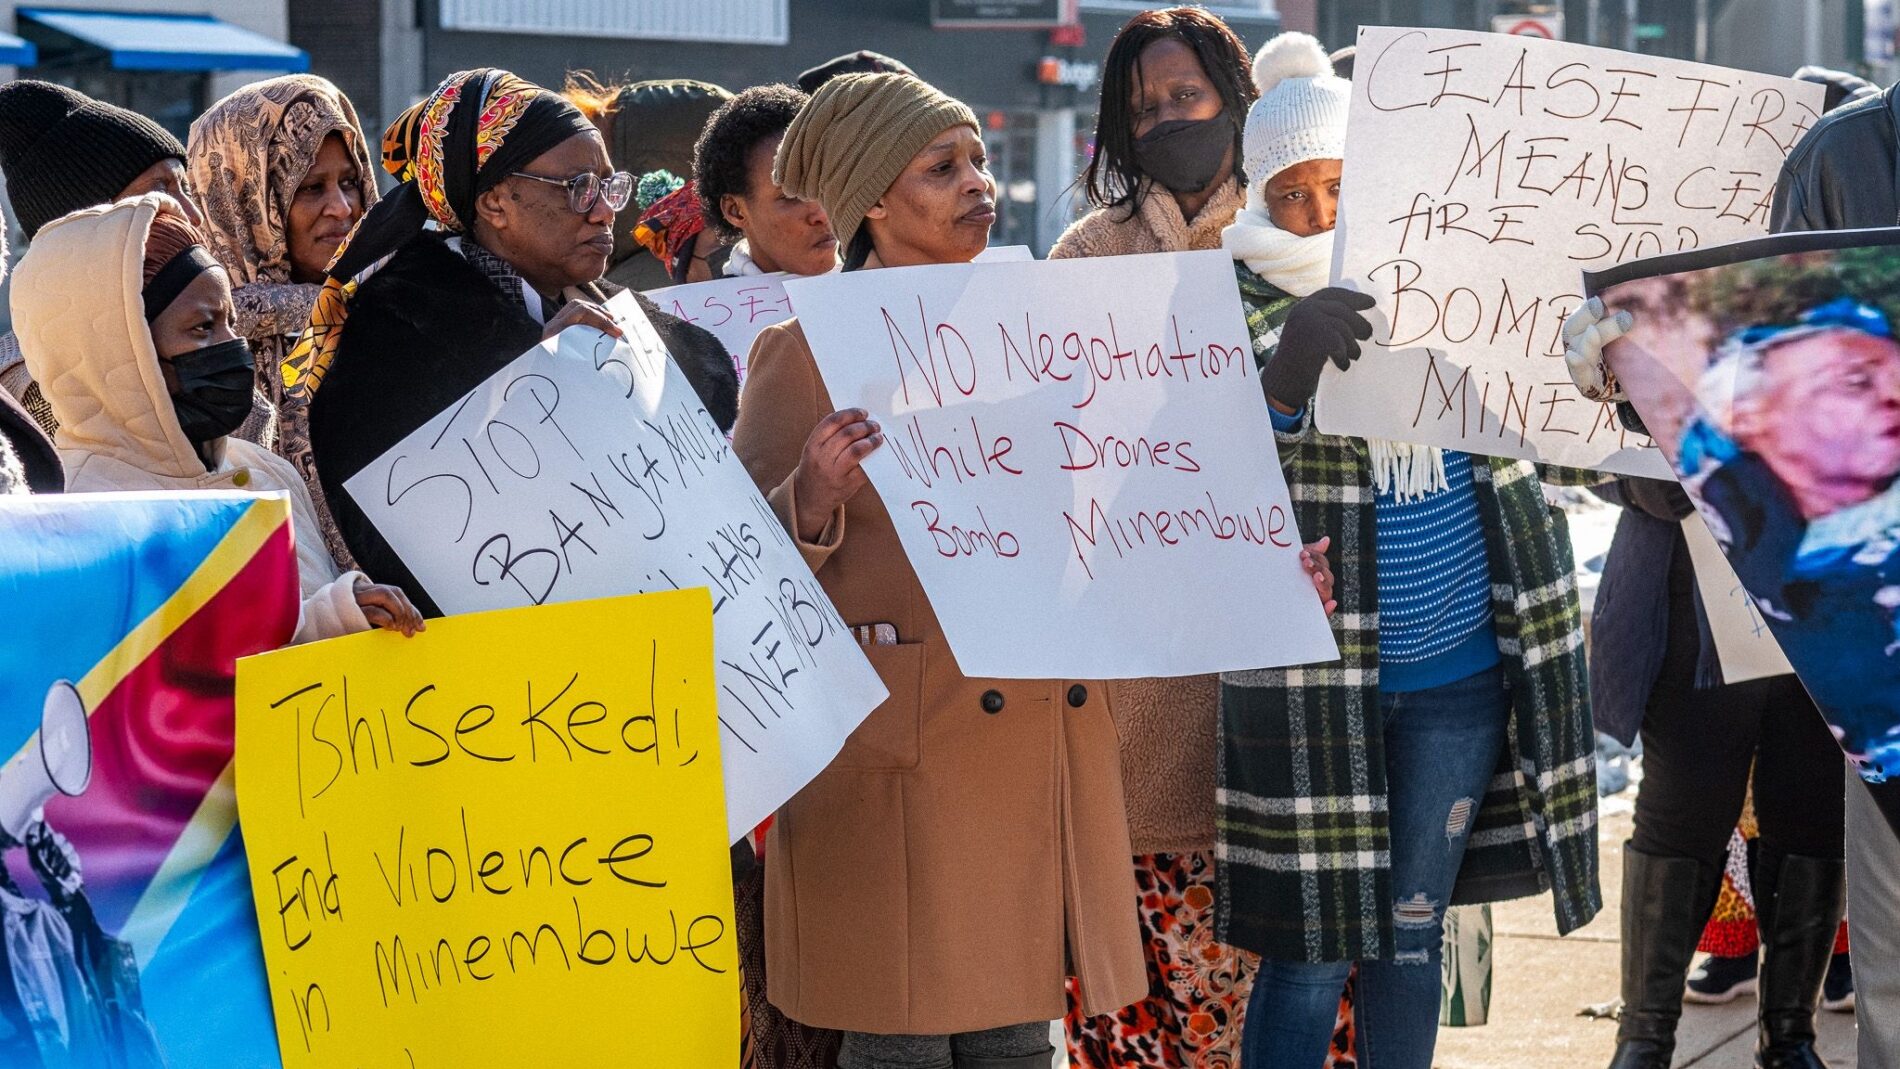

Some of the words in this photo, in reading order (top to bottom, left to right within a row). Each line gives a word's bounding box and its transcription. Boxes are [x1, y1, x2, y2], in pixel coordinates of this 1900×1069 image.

[1366, 31, 1657, 130] CEASE
[1444, 112, 1649, 213] MEANS
[1674, 166, 1778, 226] CEA
[880, 294, 976, 408] NO
[997, 312, 1246, 408] Negotiation
[386, 373, 585, 543] STOP
[881, 415, 1023, 488] While
[1053, 421, 1201, 473] Drones
[910, 500, 1020, 558] Bomb
[1062, 491, 1292, 580] Minembwe
[272, 831, 343, 951] End
[283, 971, 330, 1053] in
[374, 896, 727, 1008] Minembwe
